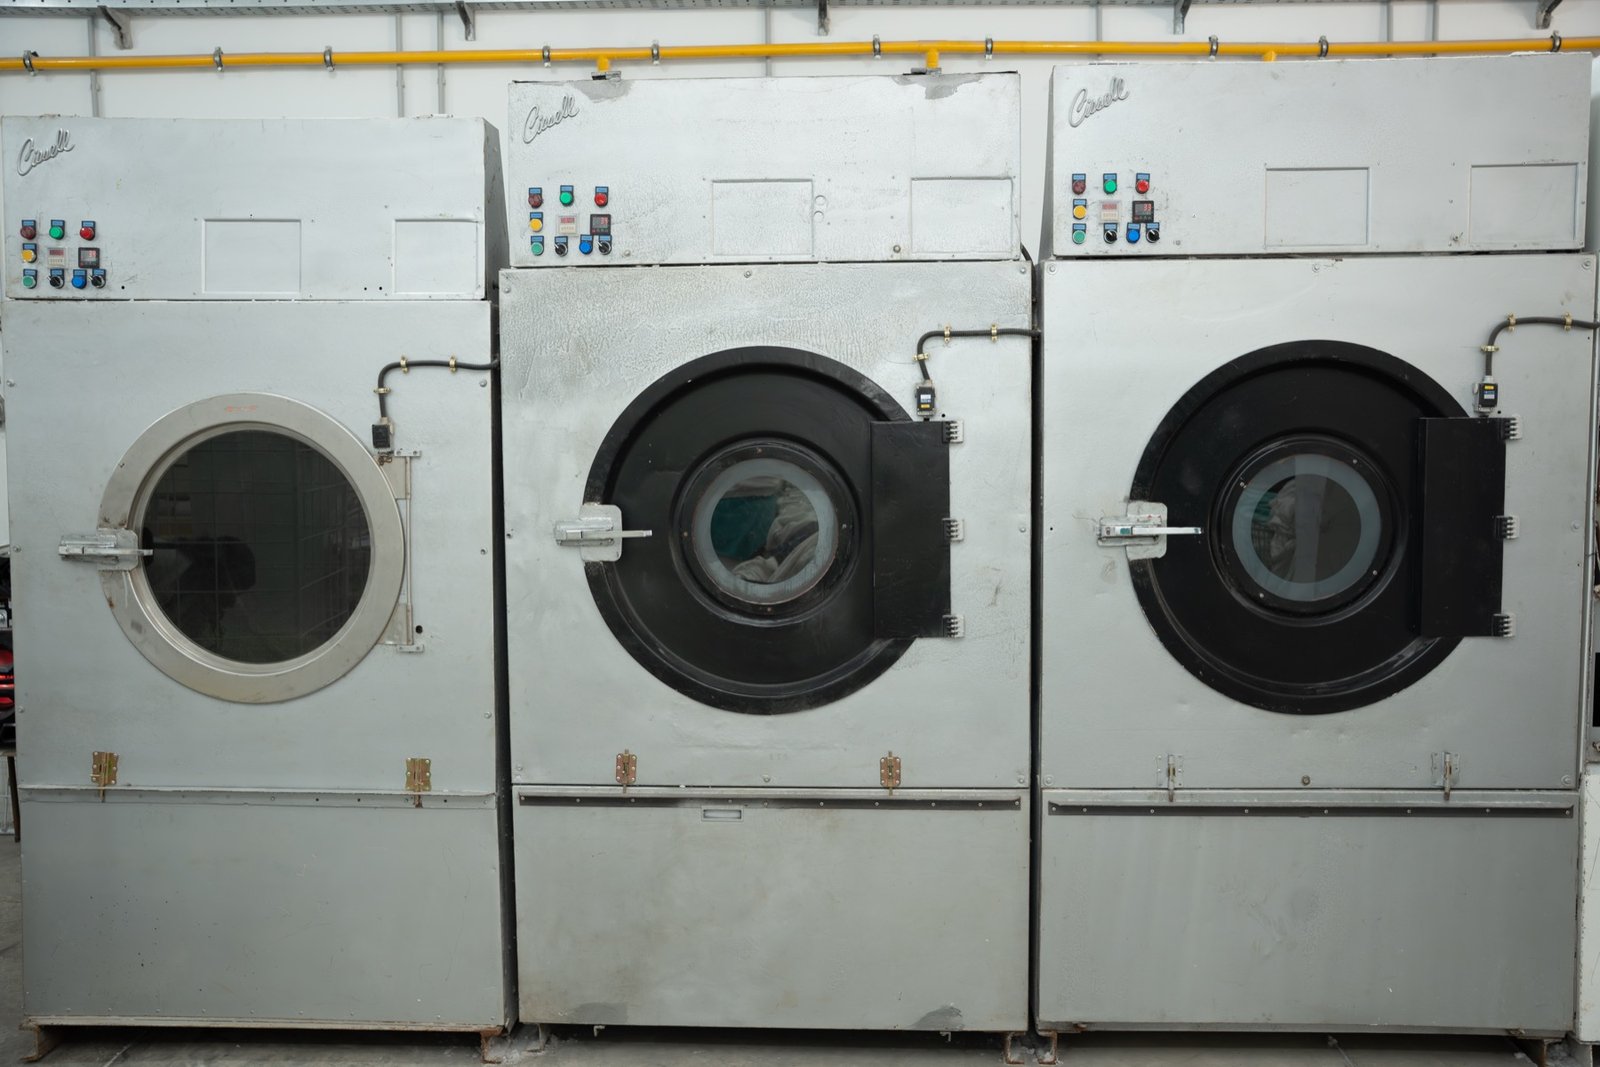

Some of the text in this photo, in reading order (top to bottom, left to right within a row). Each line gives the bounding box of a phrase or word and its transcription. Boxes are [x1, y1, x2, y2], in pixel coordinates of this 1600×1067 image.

[523, 95, 580, 144] Cissell
[1069, 76, 1130, 128] Cissell
[16, 128, 75, 176] Cissell
